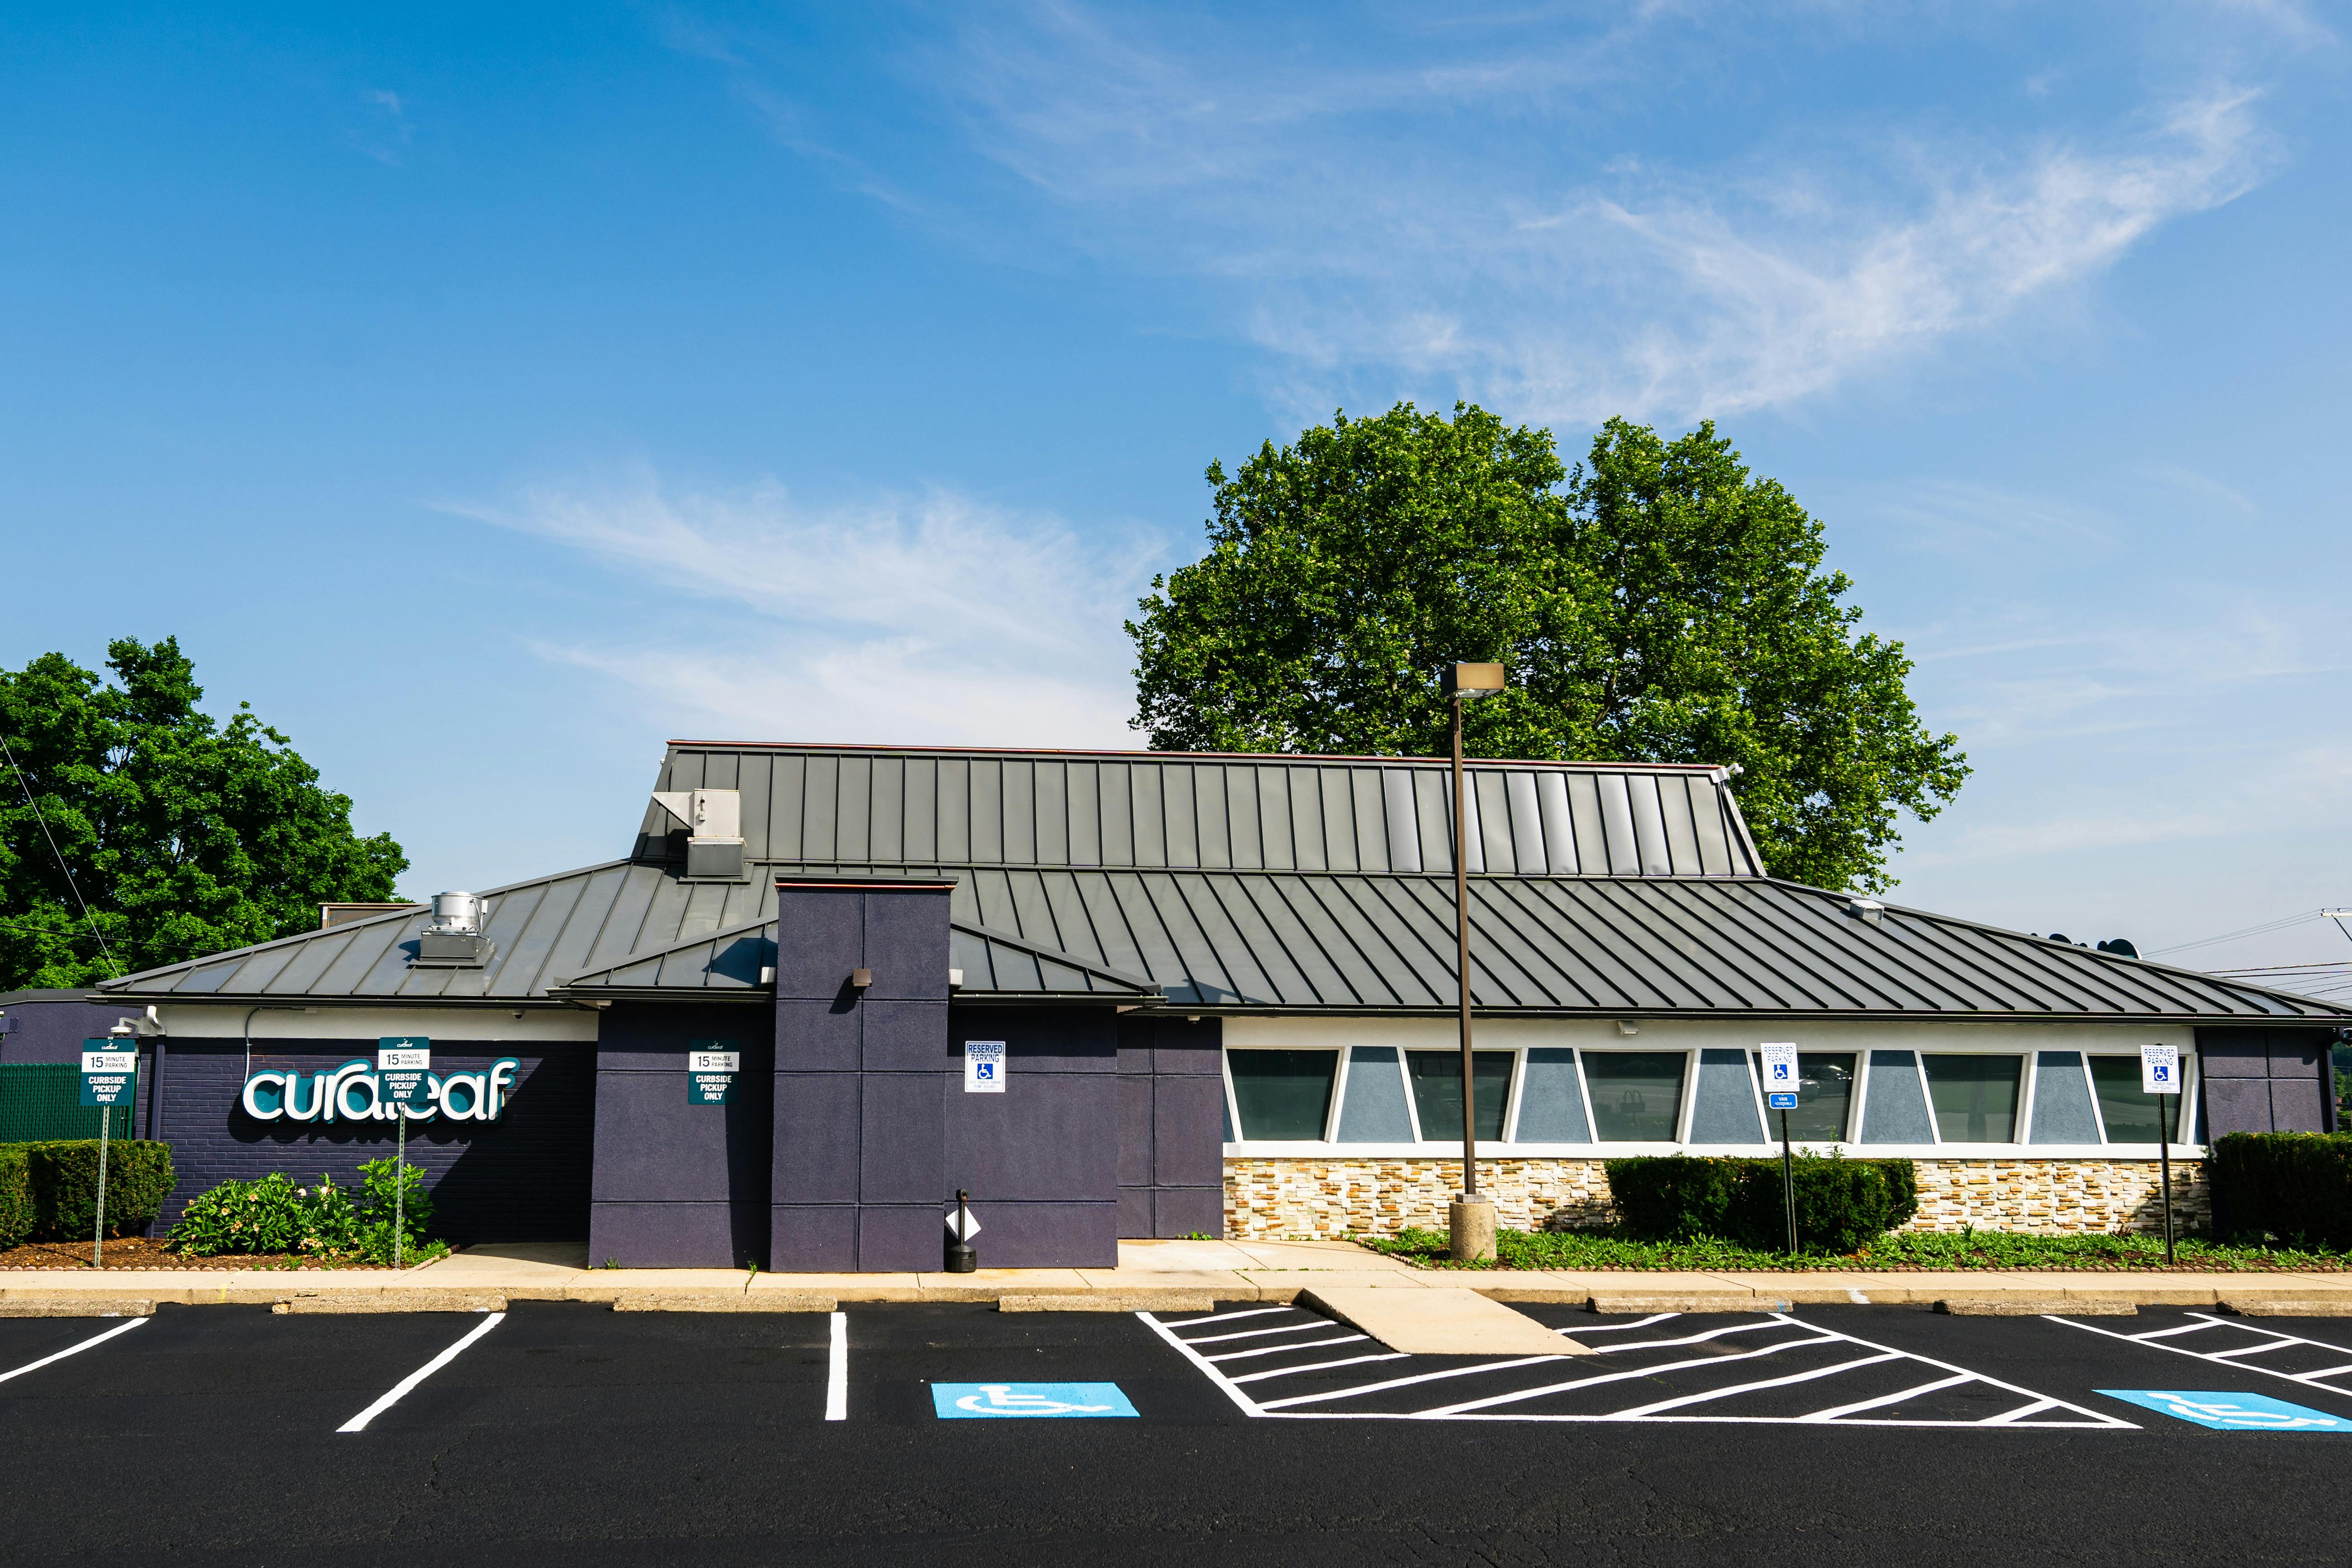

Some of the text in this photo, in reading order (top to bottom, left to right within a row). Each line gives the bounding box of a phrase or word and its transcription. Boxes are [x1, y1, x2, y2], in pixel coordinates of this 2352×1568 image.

[969, 1045, 1003, 1054] RESERVED
[1764, 1046, 1794, 1055] RESERVED
[2144, 1049, 2175, 1057] RESERVED
[90, 1057, 103, 1068] 15
[387, 1054, 399, 1065] 15
[698, 1056, 710, 1067] 15
[971, 1054, 999, 1062] PARKING
[243, 1061, 516, 1121] curaeaf
[704, 1092, 723, 1100] ONLY
